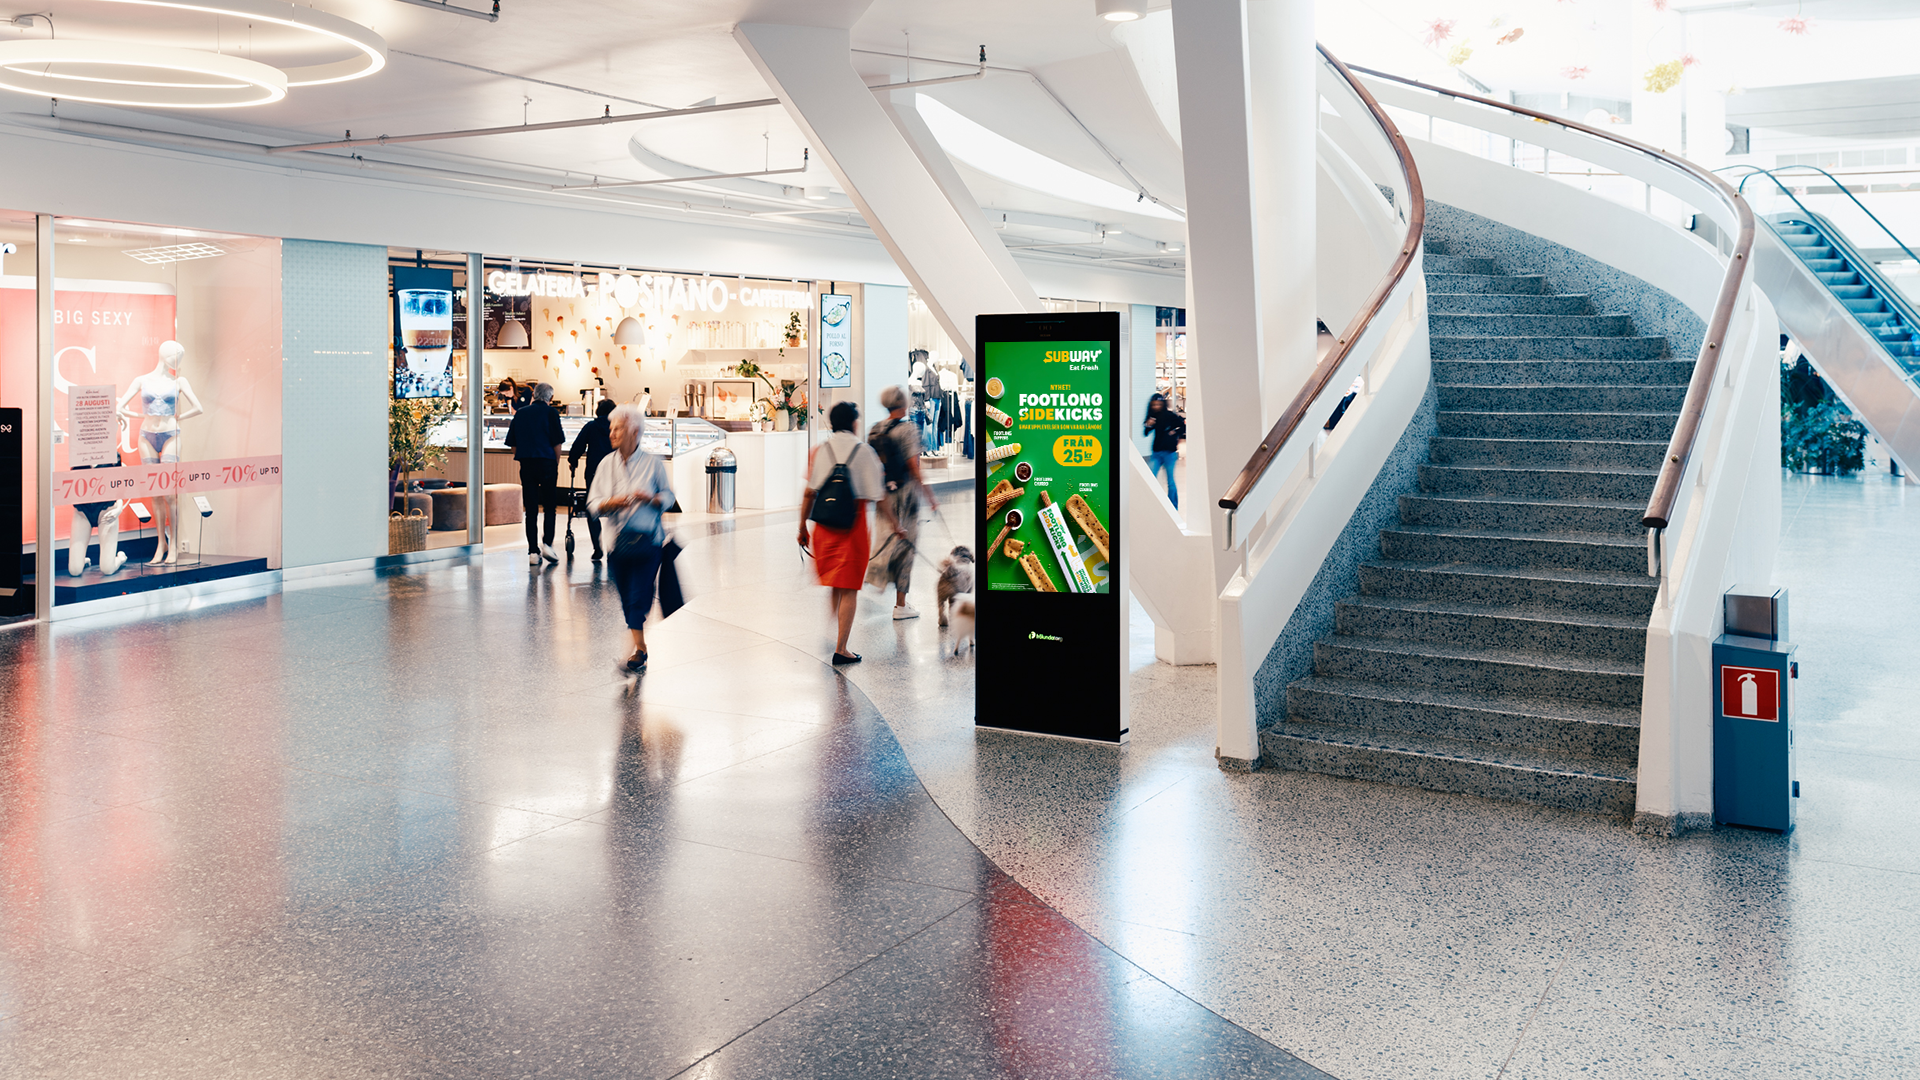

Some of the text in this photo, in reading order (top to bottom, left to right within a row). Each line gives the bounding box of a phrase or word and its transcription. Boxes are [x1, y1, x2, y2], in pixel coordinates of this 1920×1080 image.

[488, 271, 585, 298] GELATERIA
[598, 272, 729, 313] POSITANO
[54, 310, 132, 325] BIG SEXY
[1043, 350, 1102, 363] SUBWAY
[1019, 393, 1103, 406] FOOTLONG
[1019, 407, 1103, 421] SIDEKICKS
[1063, 436, 1093, 447] FRÅN
[1063, 449, 1092, 463] 25 kr
[53, 464, 279, 499] -70% UP TO -70% UP TO -70% UP TO
[1046, 508, 1067, 548] FOOTLONG
